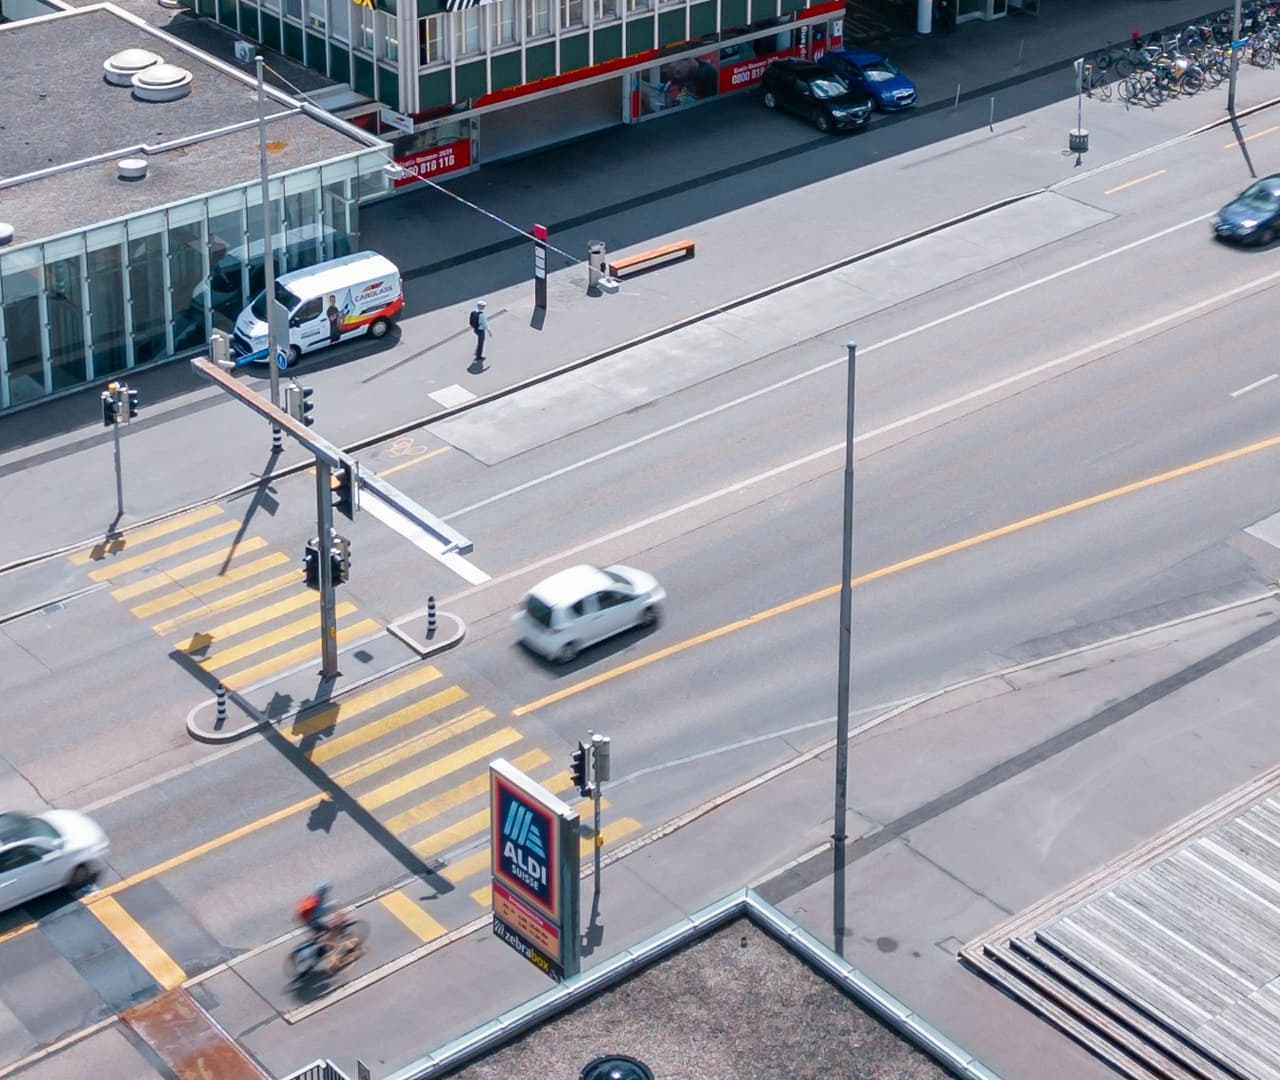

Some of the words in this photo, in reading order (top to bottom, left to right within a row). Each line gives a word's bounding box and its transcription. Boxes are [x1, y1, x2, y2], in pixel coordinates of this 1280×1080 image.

[503, 840, 546, 886] ALDI
[511, 864, 539, 890] SUISSE
[504, 931, 549, 969] zebrabox
